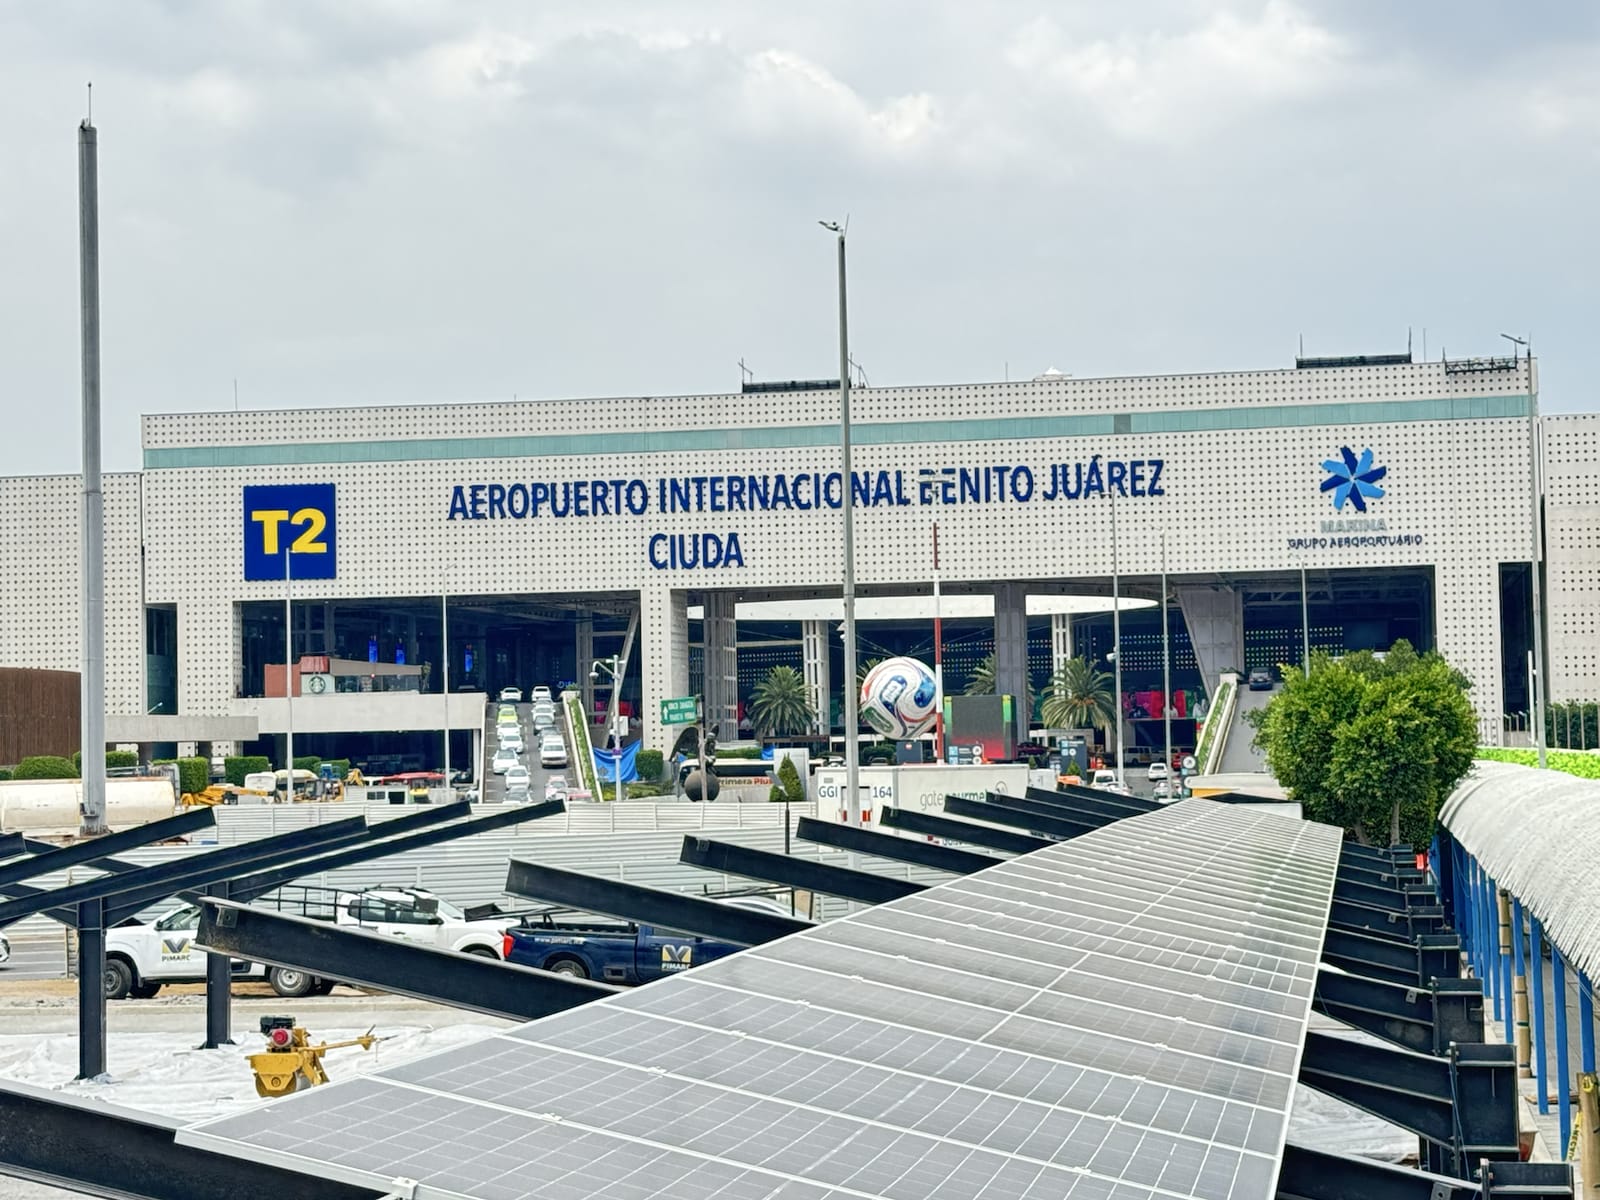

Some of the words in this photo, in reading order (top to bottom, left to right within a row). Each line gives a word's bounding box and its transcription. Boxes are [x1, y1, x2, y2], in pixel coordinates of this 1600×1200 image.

[447, 479, 648, 520] AEROPUERTO
[659, 471, 910, 513] INTERNACIONAL
[919, 465, 1035, 505] BENITO
[1042, 454, 1165, 501] JUÁREZ
[251, 508, 327, 554] T2
[1320, 518, 1388, 534] MARINA
[648, 532, 745, 569] CIUDA
[1287, 538, 1327, 549] GRUPO
[1329, 534, 1423, 548] AEROPORTUARIO
[872, 785, 893, 799] 164
